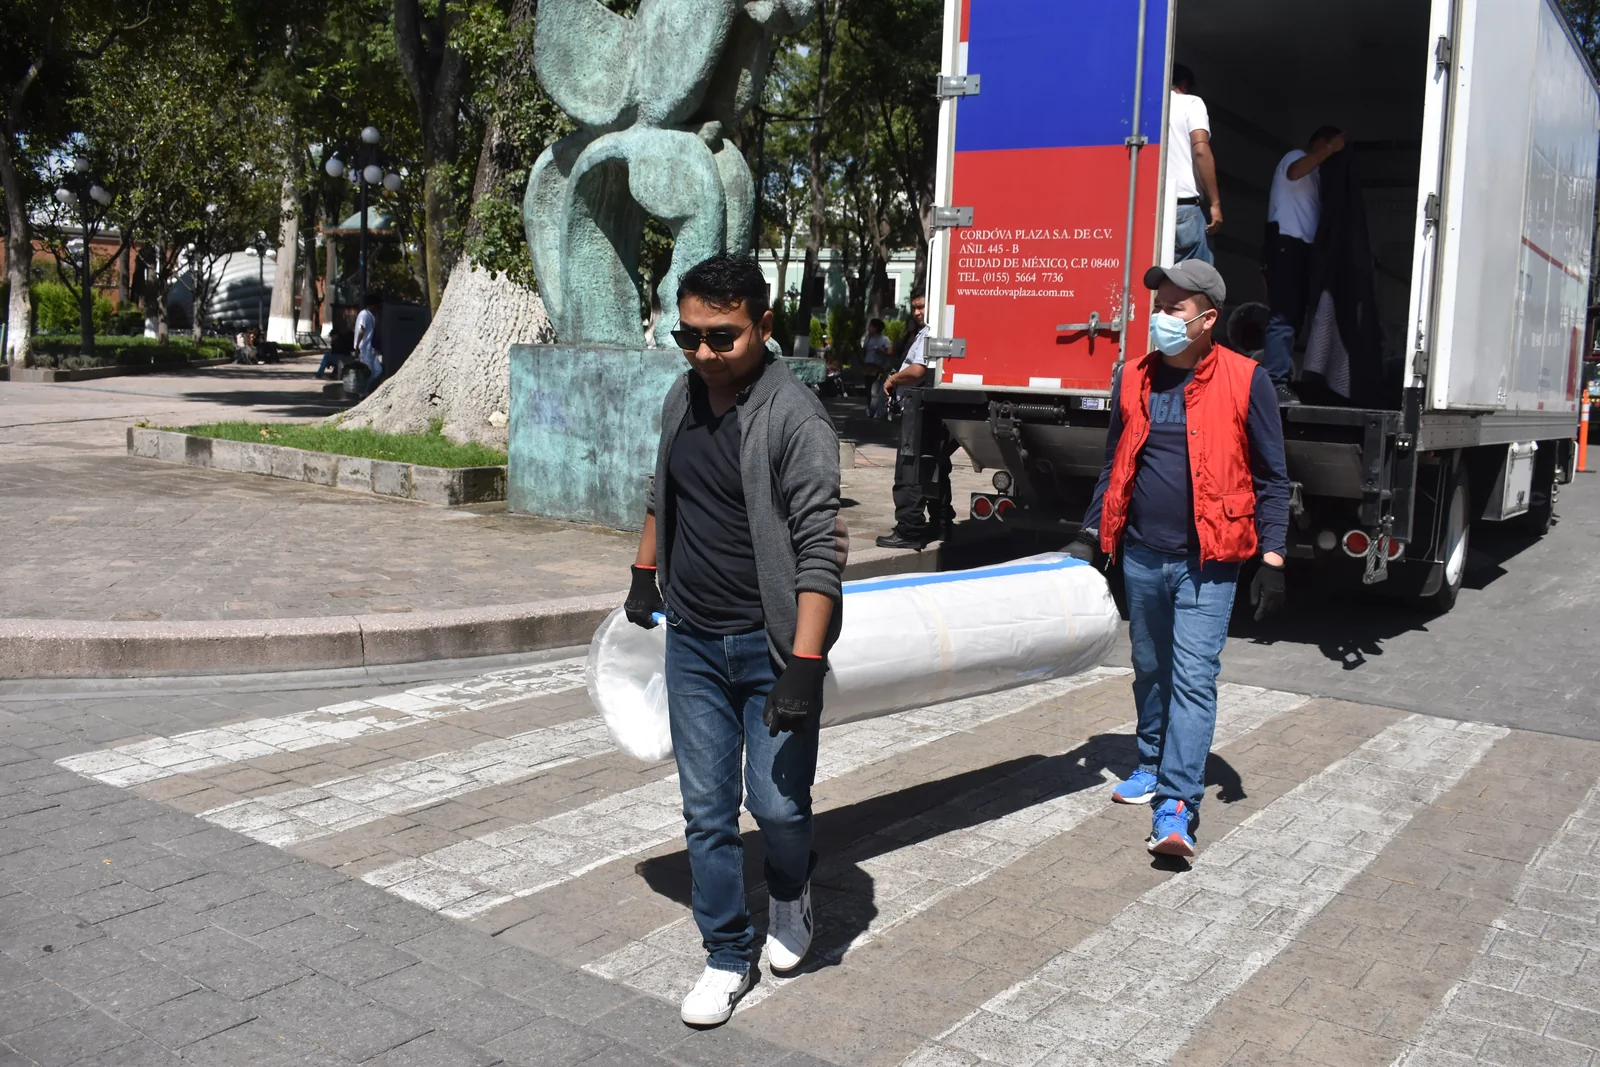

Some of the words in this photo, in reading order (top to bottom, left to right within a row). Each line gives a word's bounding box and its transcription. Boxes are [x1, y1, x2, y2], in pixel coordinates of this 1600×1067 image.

[960, 227, 1012, 240] CORDÓVA
[1015, 229, 1050, 240] PLAZA
[1053, 229, 1071, 240] S.A.
[1074, 228, 1091, 239] DE
[1093, 228, 1113, 239] C.V.
[960, 243, 985, 254] AÑIL
[988, 244, 1003, 254] 445
[1012, 244, 1019, 254] B
[959, 258, 1000, 268] CIUDAD
[1003, 258, 1019, 268] DE
[1022, 255, 1069, 270] MÉXICO,
[1090, 258, 1119, 268] 08400
[958, 272, 980, 282] TEL.
[982, 272, 1009, 284] (0155)
[1015, 272, 1036, 282] 5664
[1042, 272, 1063, 282] 7736
[957, 287, 1074, 299] www.cordovaplaza.com.mx
